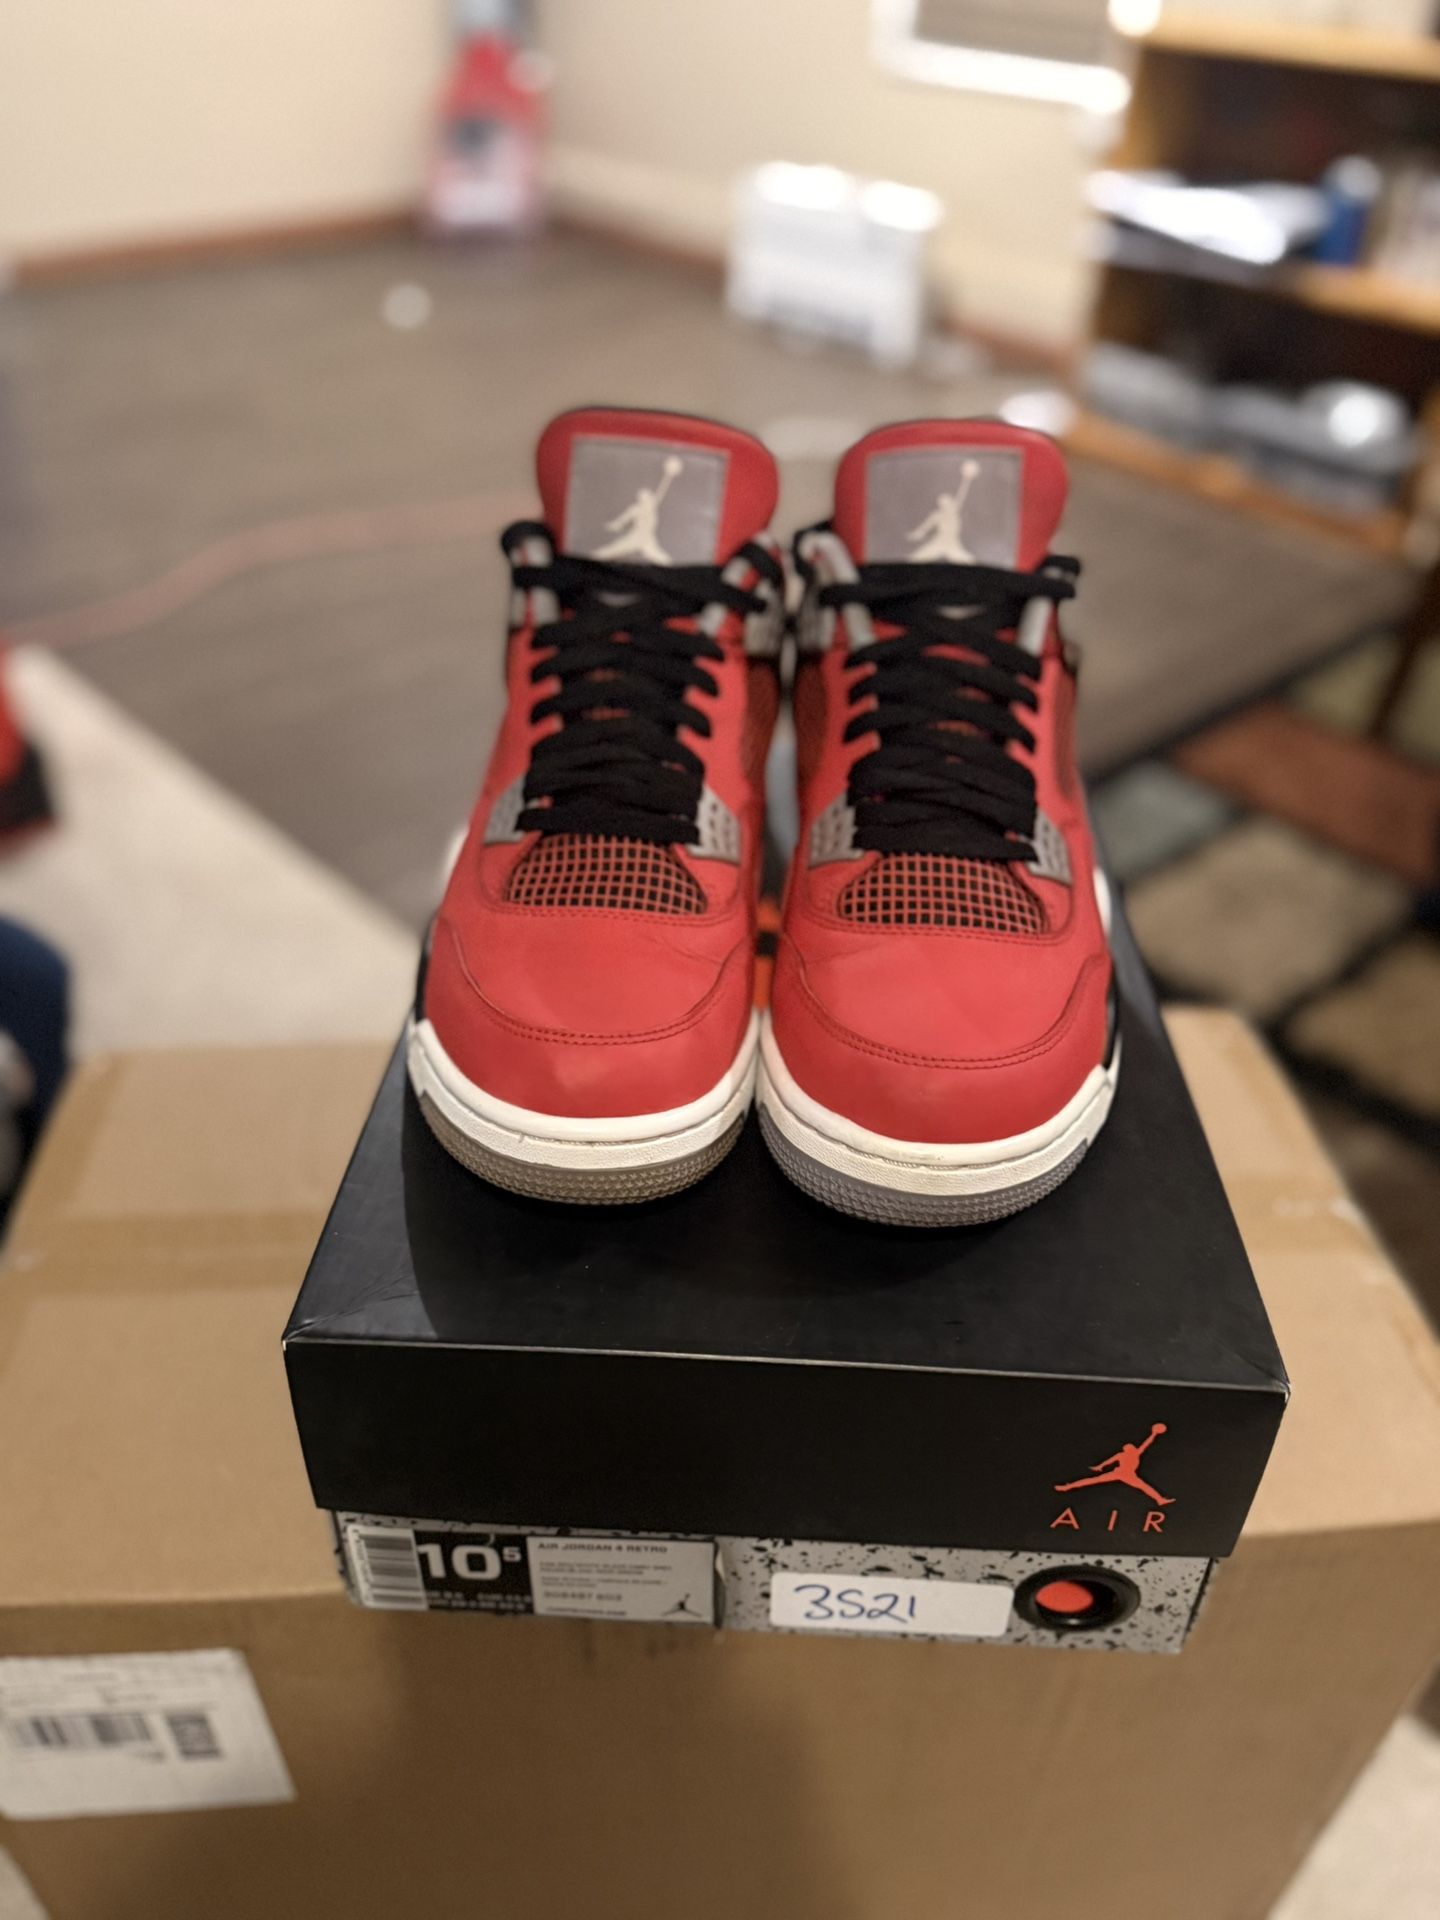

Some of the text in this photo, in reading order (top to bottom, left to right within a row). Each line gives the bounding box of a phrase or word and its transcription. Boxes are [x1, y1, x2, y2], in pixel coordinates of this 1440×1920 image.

[1050, 1507, 1166, 1533] AIR
[537, 1541, 669, 1554] AIR JORDAN 4 RETRO
